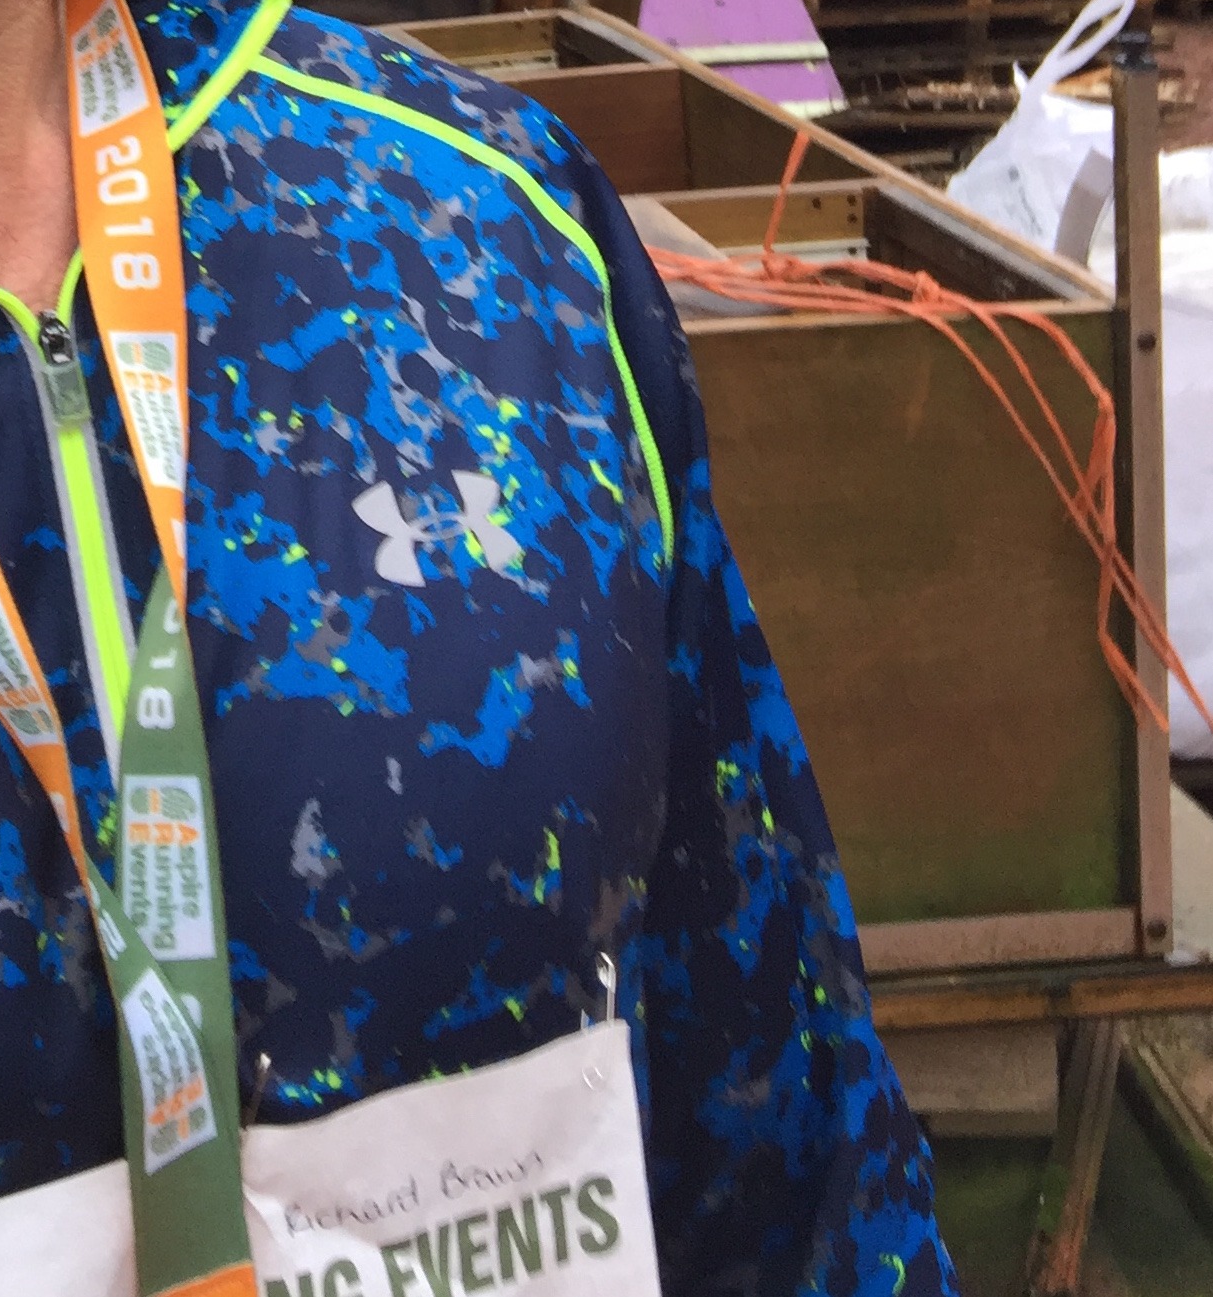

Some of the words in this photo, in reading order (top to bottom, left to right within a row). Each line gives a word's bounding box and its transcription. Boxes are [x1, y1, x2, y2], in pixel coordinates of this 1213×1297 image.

[95, 135, 162, 290] 2018
[129, 822, 151, 927] Events
[152, 822, 178, 950] Running
[175, 821, 202, 919] Aspire
[380, 1173, 620, 1297] EVENTS
